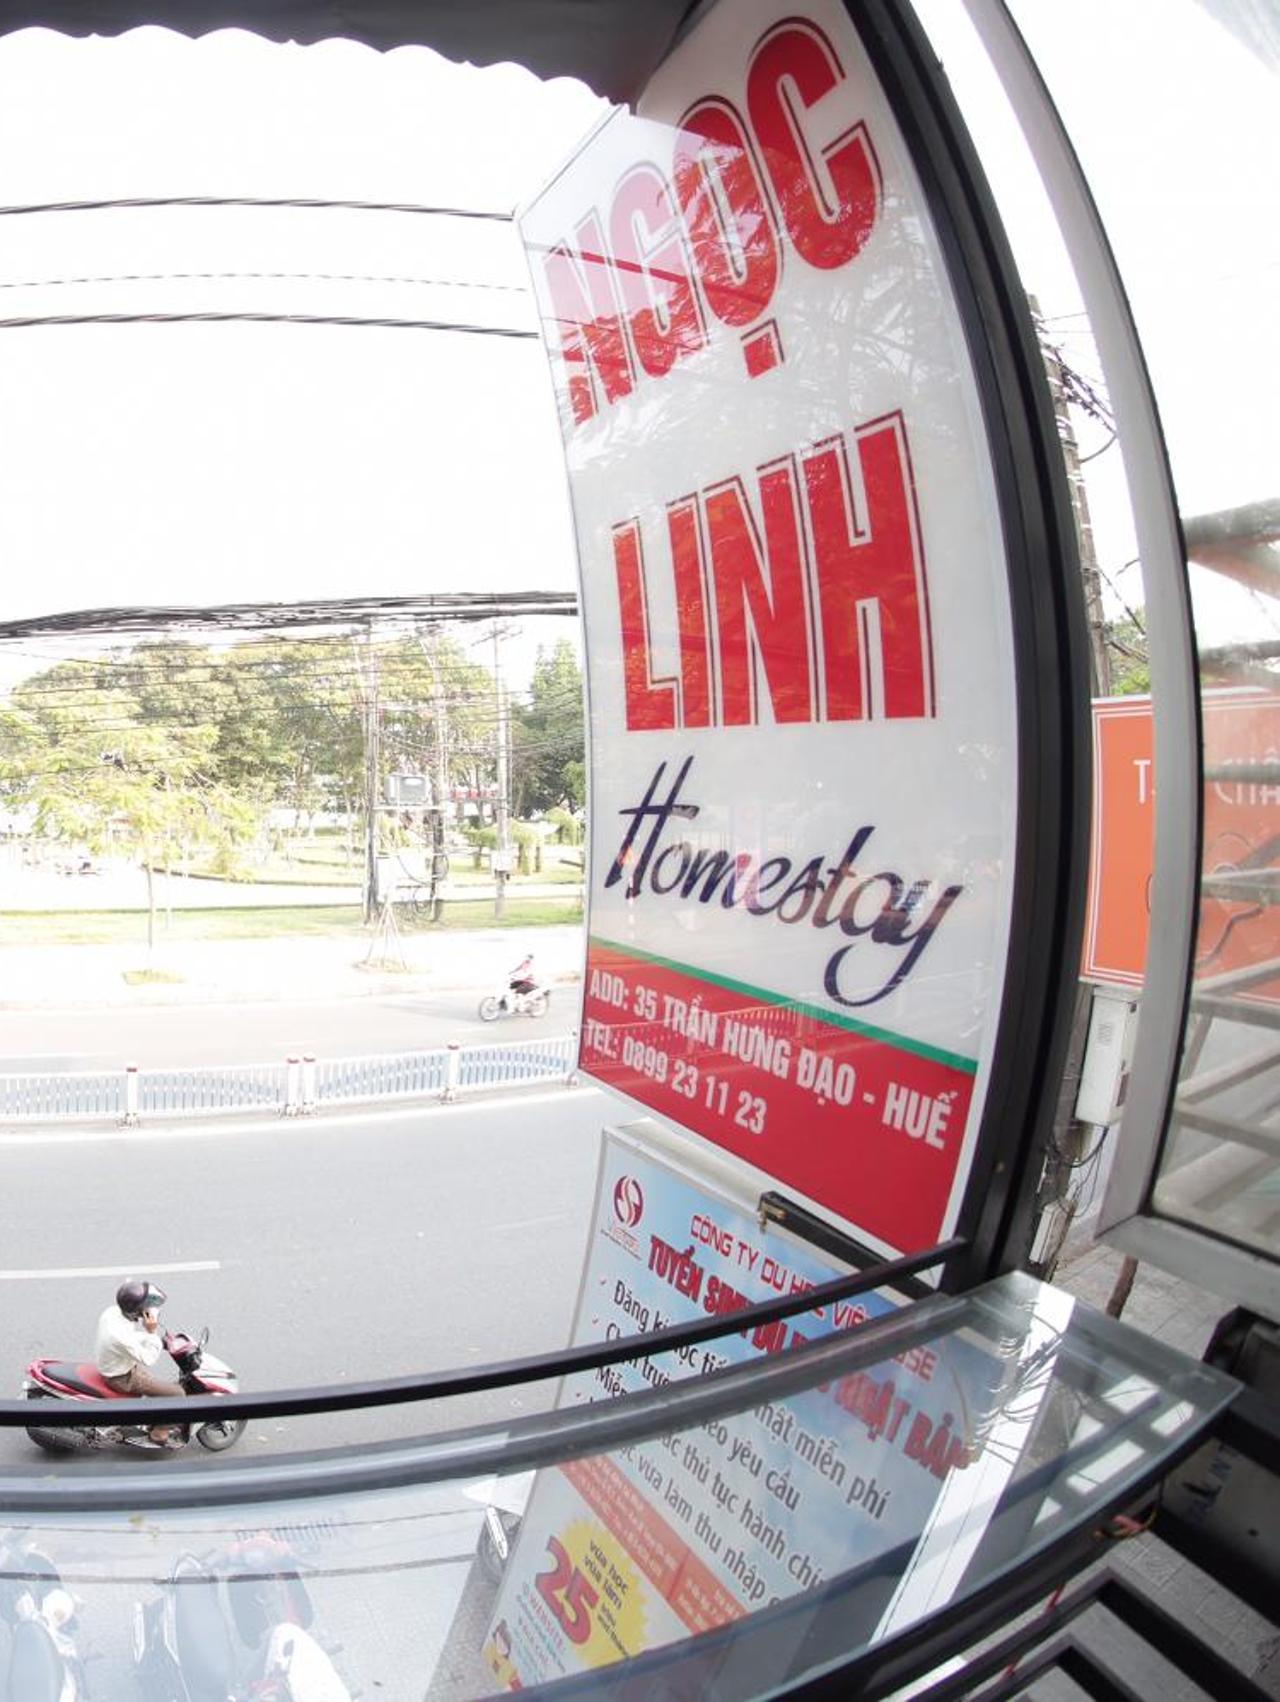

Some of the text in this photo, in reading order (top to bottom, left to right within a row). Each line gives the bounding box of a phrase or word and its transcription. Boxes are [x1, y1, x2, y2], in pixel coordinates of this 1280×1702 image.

[540, 17, 883, 425] NGỌC
[610, 410, 938, 732] LINH
[604, 755, 964, 1008] Homestay
[584, 1018, 767, 1135] TEL: 0899 23 11 23
[589, 968, 629, 1012] ADD:
[633, 985, 658, 1021] 35
[662, 994, 718, 1048] TRẦN
[722, 1018, 791, 1080] HƯNG
[796, 1048, 856, 1106] ĐẠO
[881, 1082, 958, 1150] HUẾ
[647, 1235, 704, 1304] TUYỂN
[690, 1213, 734, 1256] CÔNG
[737, 1240, 760, 1272] TY
[760, 1257, 787, 1291] DU
[614, 1280, 649, 1333] Đăng
[795, 1431, 846, 1486] miễn
[846, 1476, 892, 1519] phí
[682, 1444, 710, 1484] thủ
[711, 1471, 739, 1514] tục
[740, 1498, 786, 1560] hành
[726, 1437, 763, 1478] yêu
[765, 1467, 801, 1511] cầu
[535, 1535, 600, 1645] 25
[694, 1512, 722, 1553] thu
[723, 1547, 765, 1602] nhập
